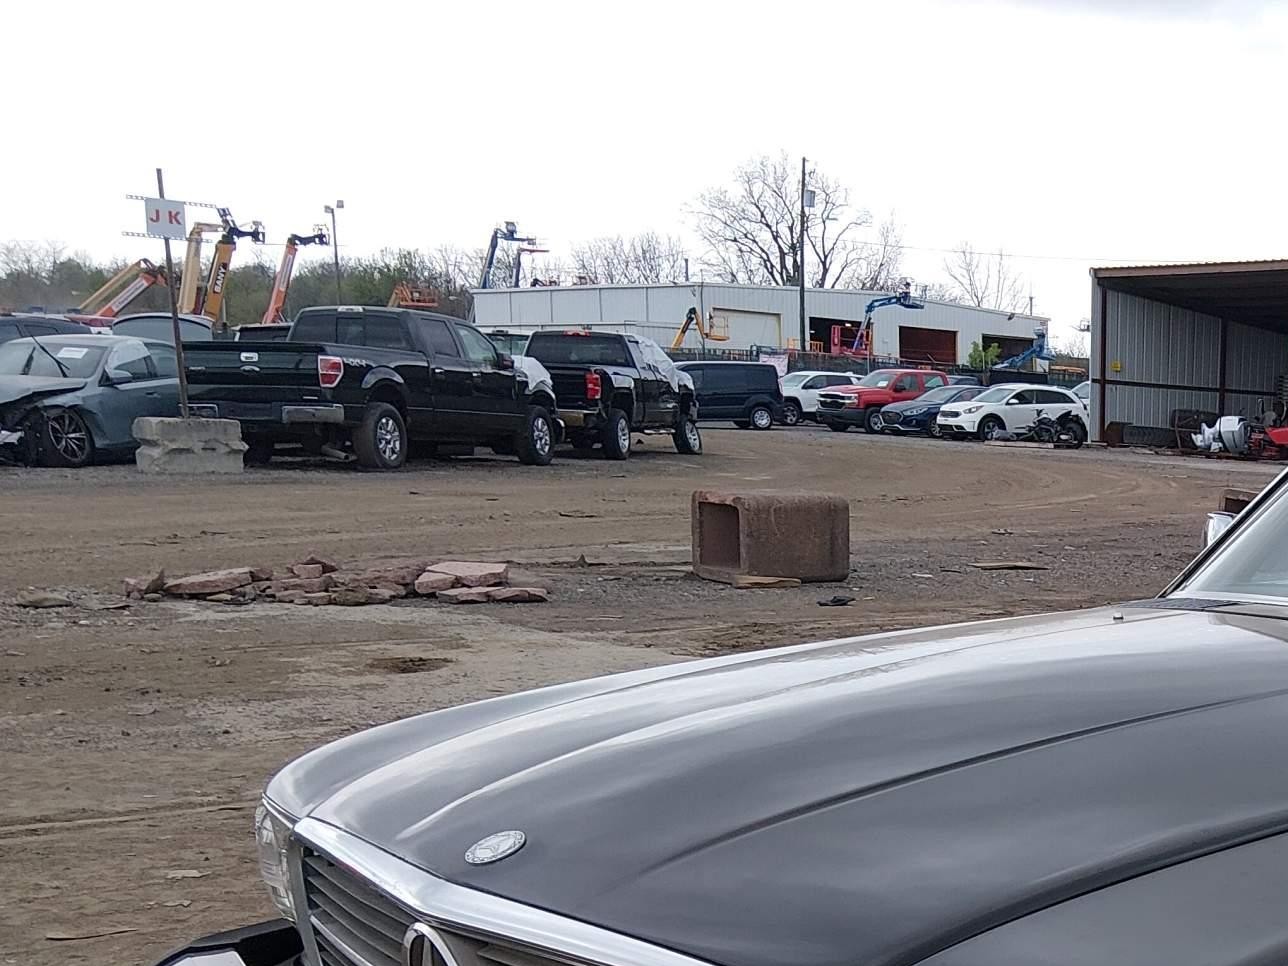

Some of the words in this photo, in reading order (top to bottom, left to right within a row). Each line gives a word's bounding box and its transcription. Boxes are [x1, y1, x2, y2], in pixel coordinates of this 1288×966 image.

[149, 209, 160, 223] J
[168, 210, 182, 225] K
[214, 266, 226, 293] SANY
